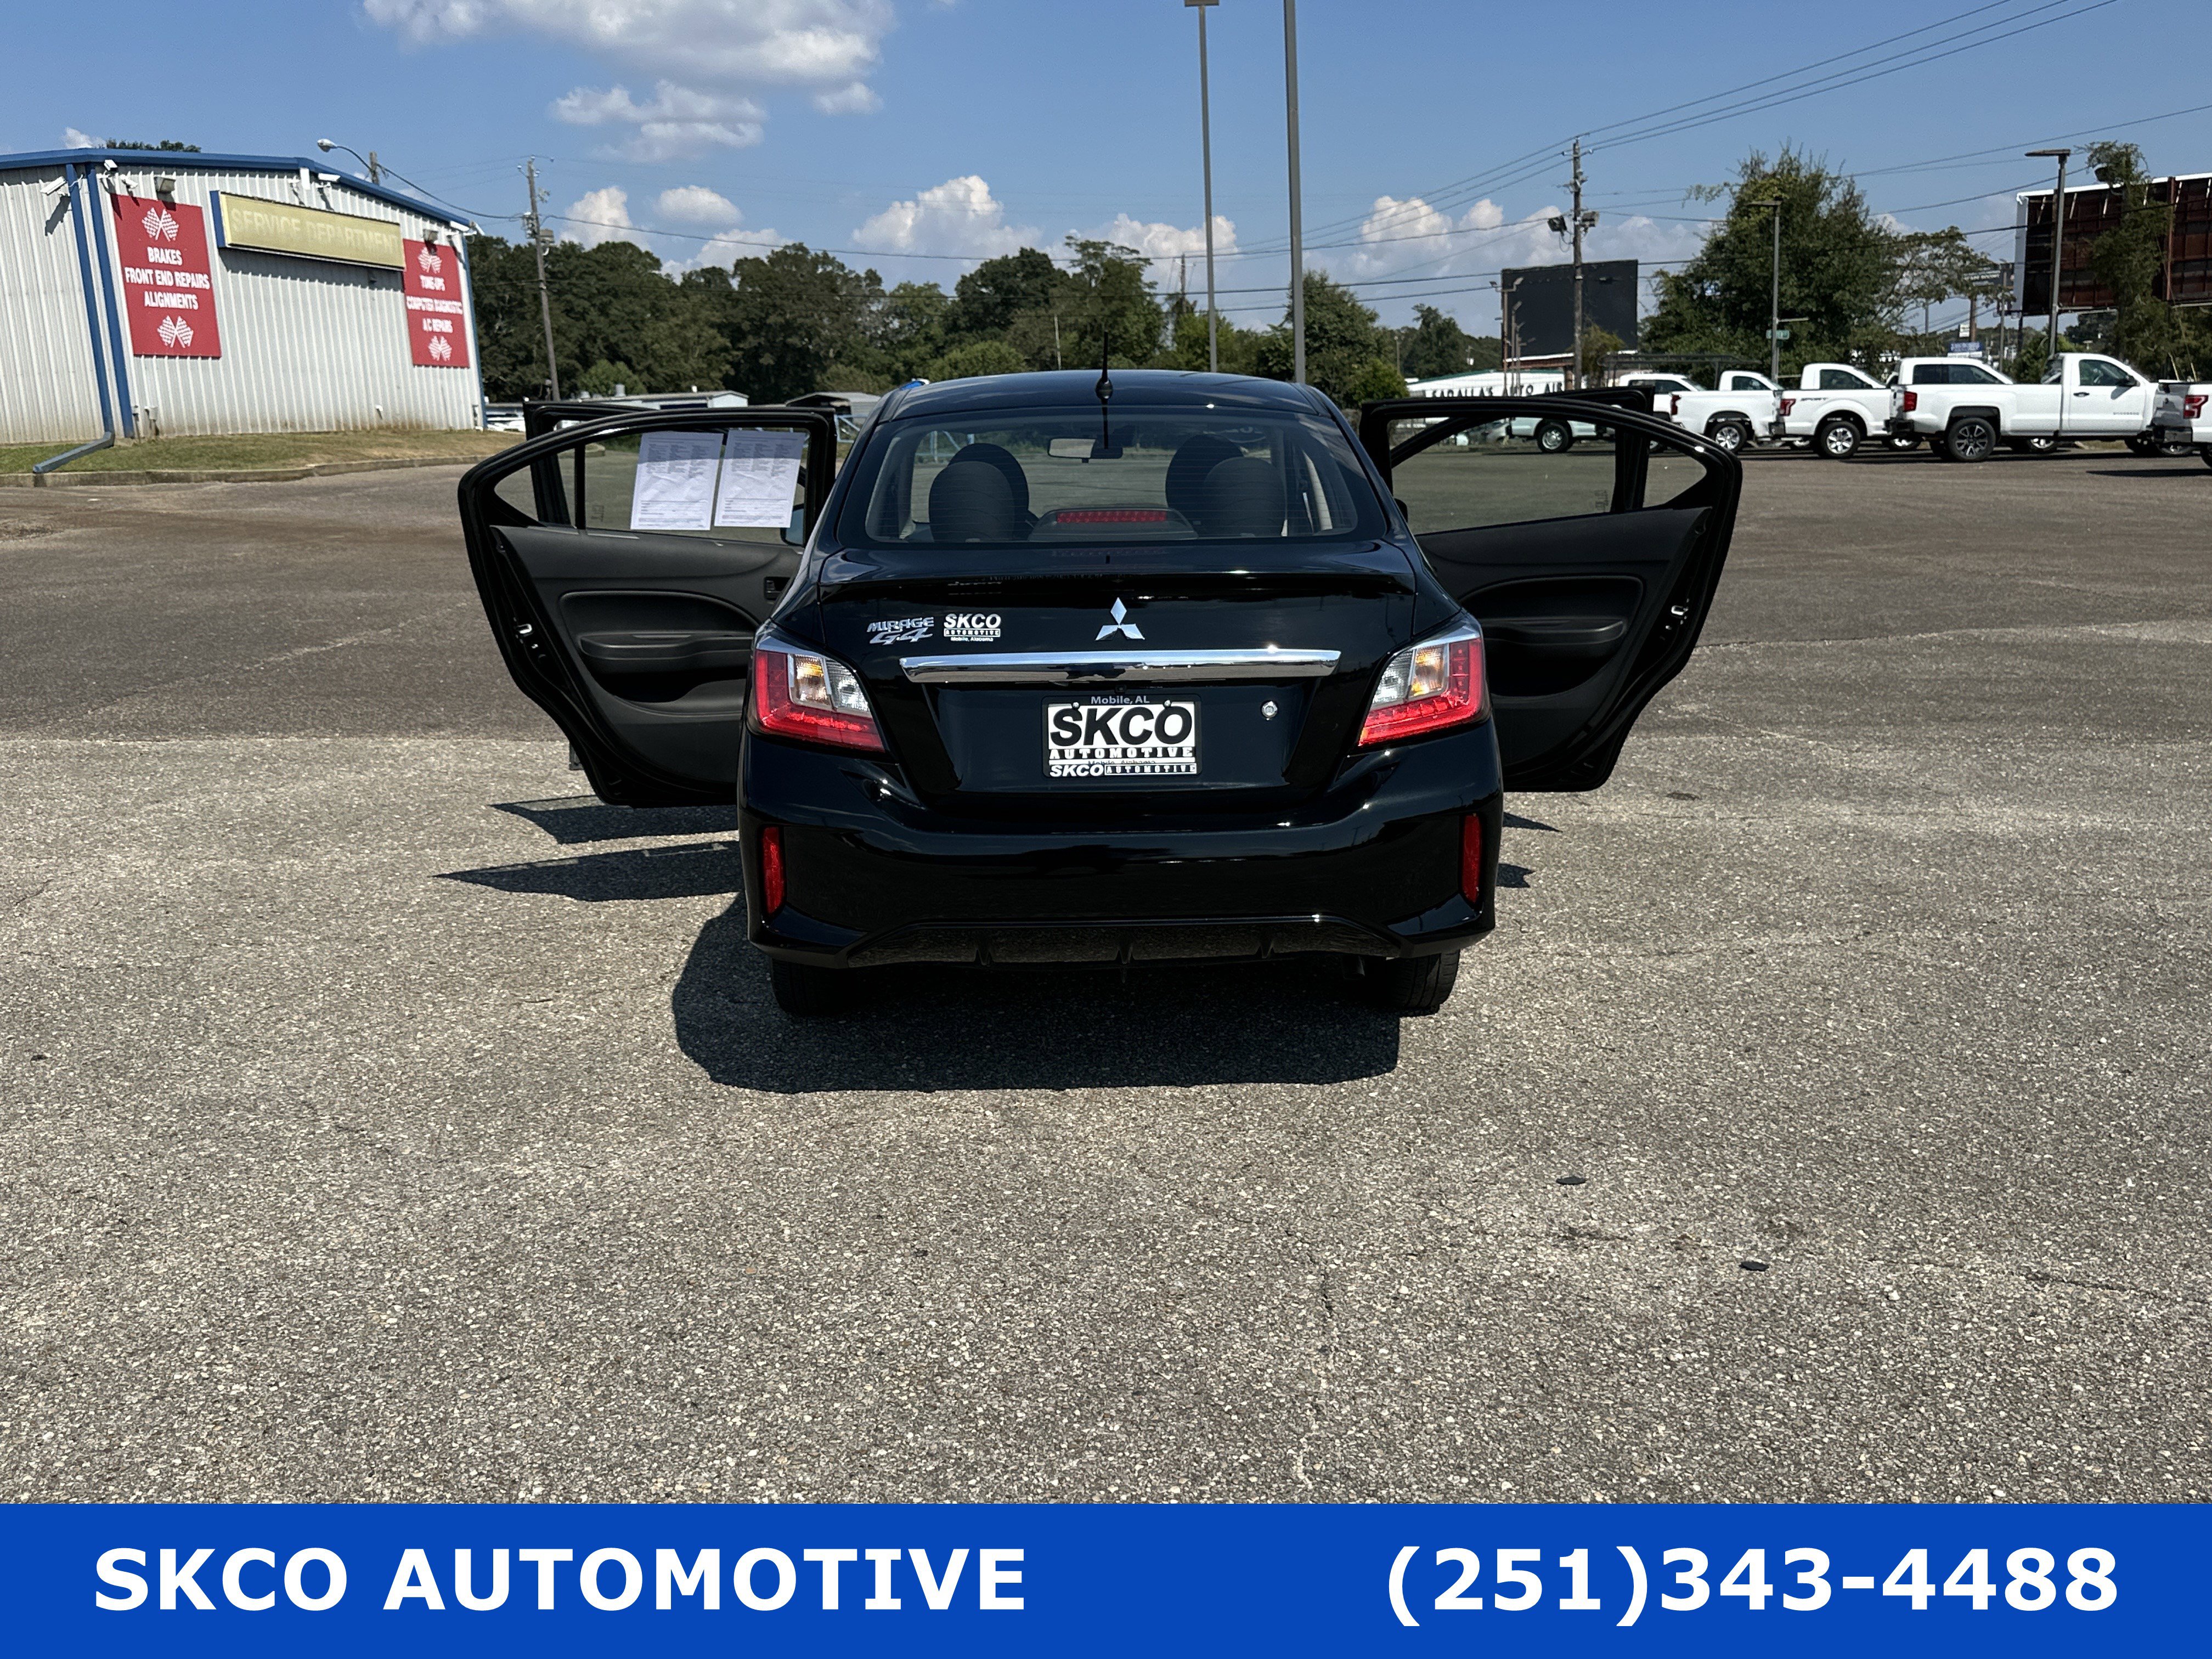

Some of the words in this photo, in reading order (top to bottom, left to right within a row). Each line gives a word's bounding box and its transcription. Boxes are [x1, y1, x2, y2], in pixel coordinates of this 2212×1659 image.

[230, 207, 301, 238] SERVICE
[147, 246, 183, 266] BRAKES
[124, 267, 154, 285] FRONT
[155, 269, 174, 286] END
[174, 272, 210, 290] REPAIRS
[144, 291, 199, 311] ALIGNMENTS
[867, 617, 934, 632] MIRAGE
[944, 613, 1001, 628] SKCO
[869, 627, 933, 645] G4
[1091, 696, 1133, 705] Mobile,
[1135, 696, 1150, 704] AL
[1050, 706, 1193, 747] SKCO
[1049, 747, 1193, 759] AUTOMOTIVE
[1049, 765, 1104, 777] SKCO
[1106, 765, 1197, 774] AUTOMOTIVE
